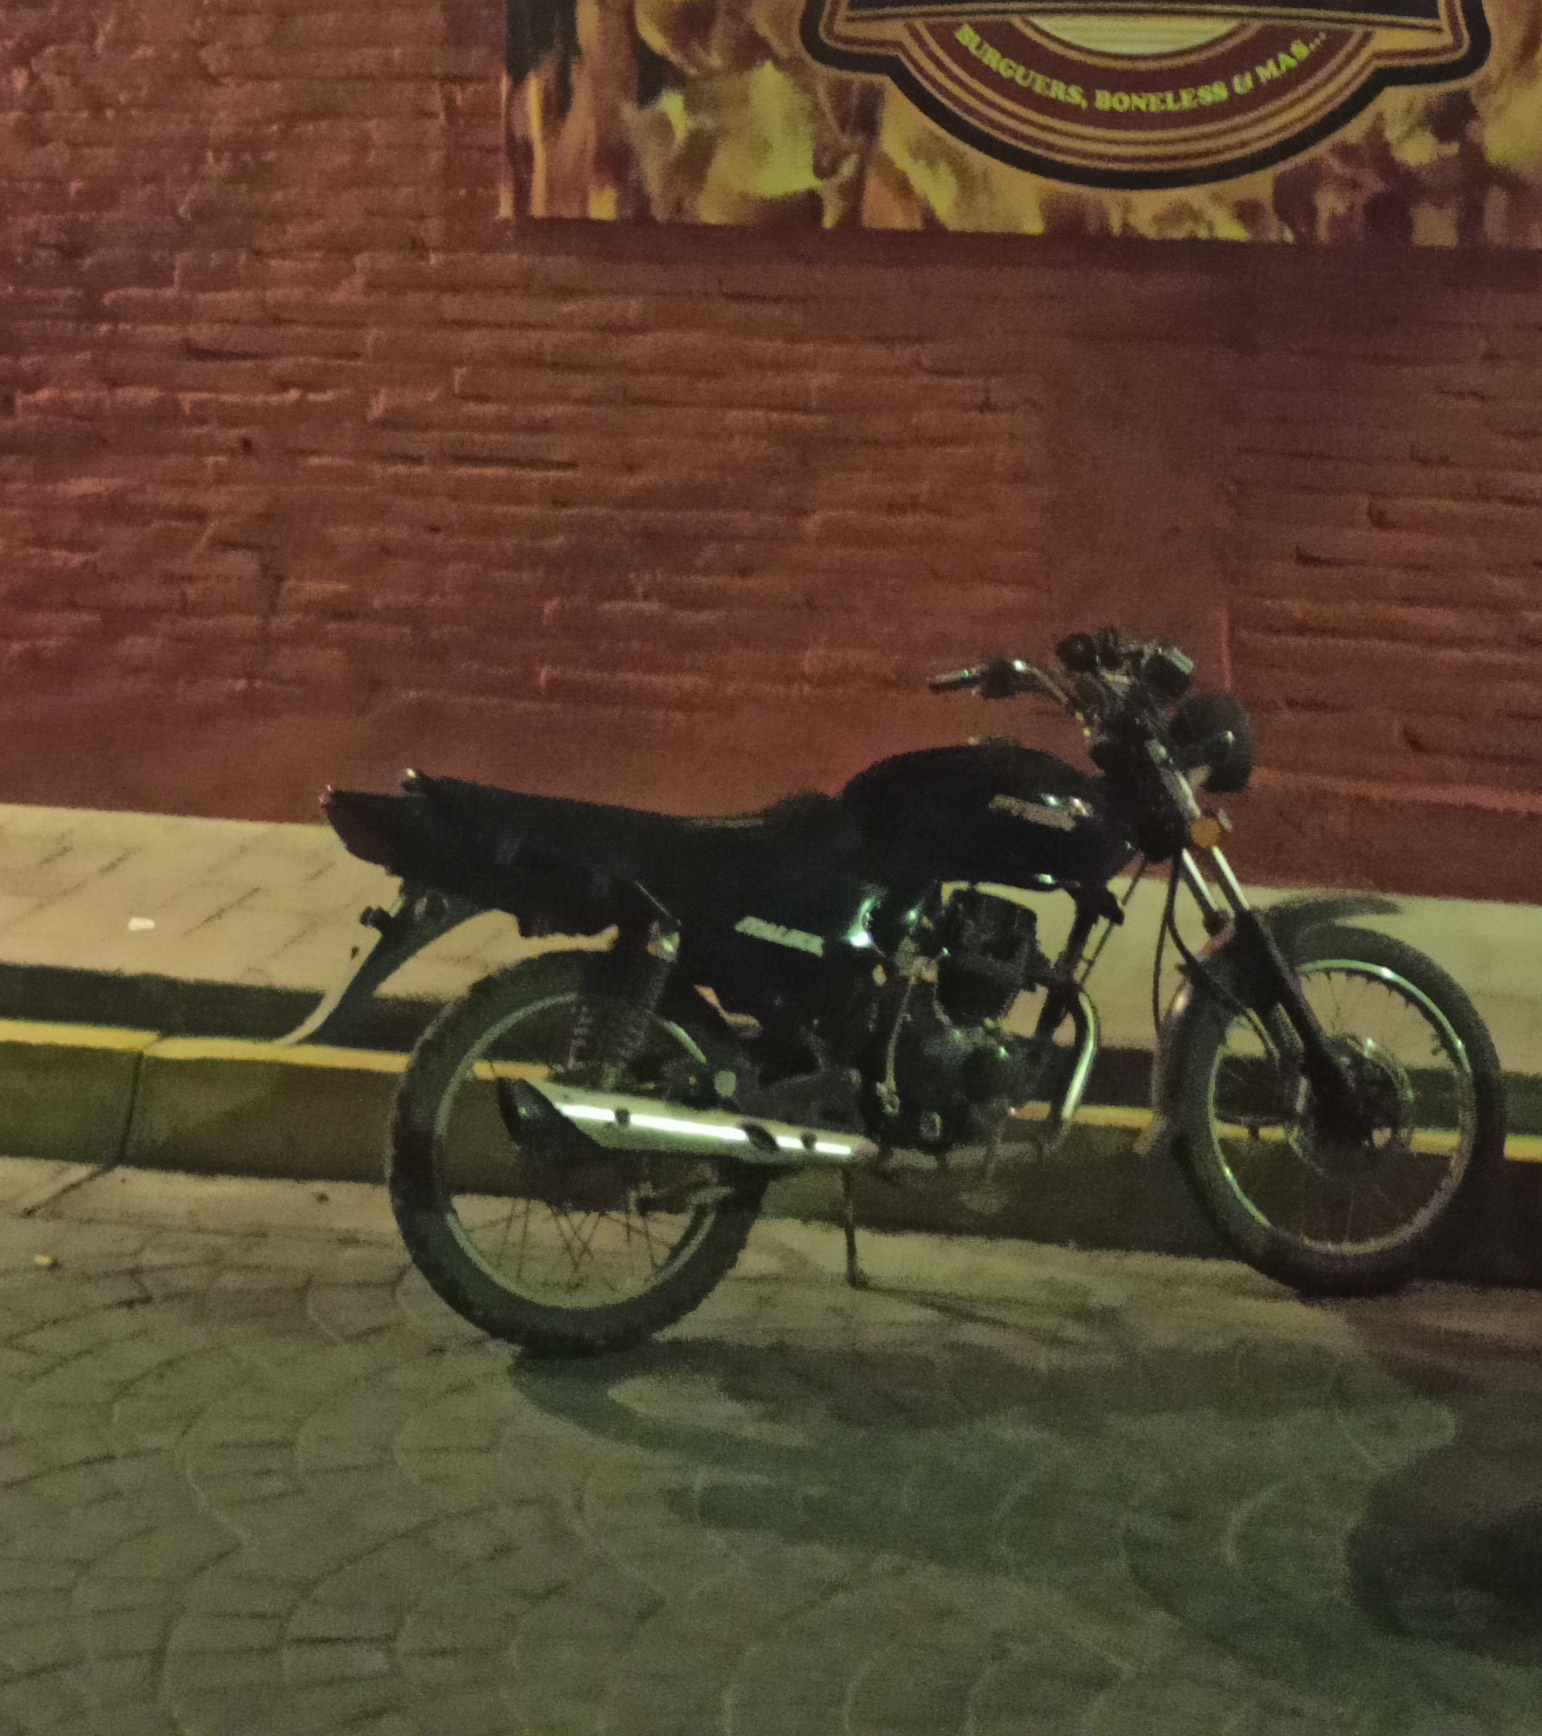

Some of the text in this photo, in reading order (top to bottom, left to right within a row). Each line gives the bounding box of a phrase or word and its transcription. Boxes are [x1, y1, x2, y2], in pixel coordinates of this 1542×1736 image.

[954, 23, 1089, 111] BURGUERS,
[1094, 81, 1230, 113] BONELESS
[1233, 71, 1255, 95] &
